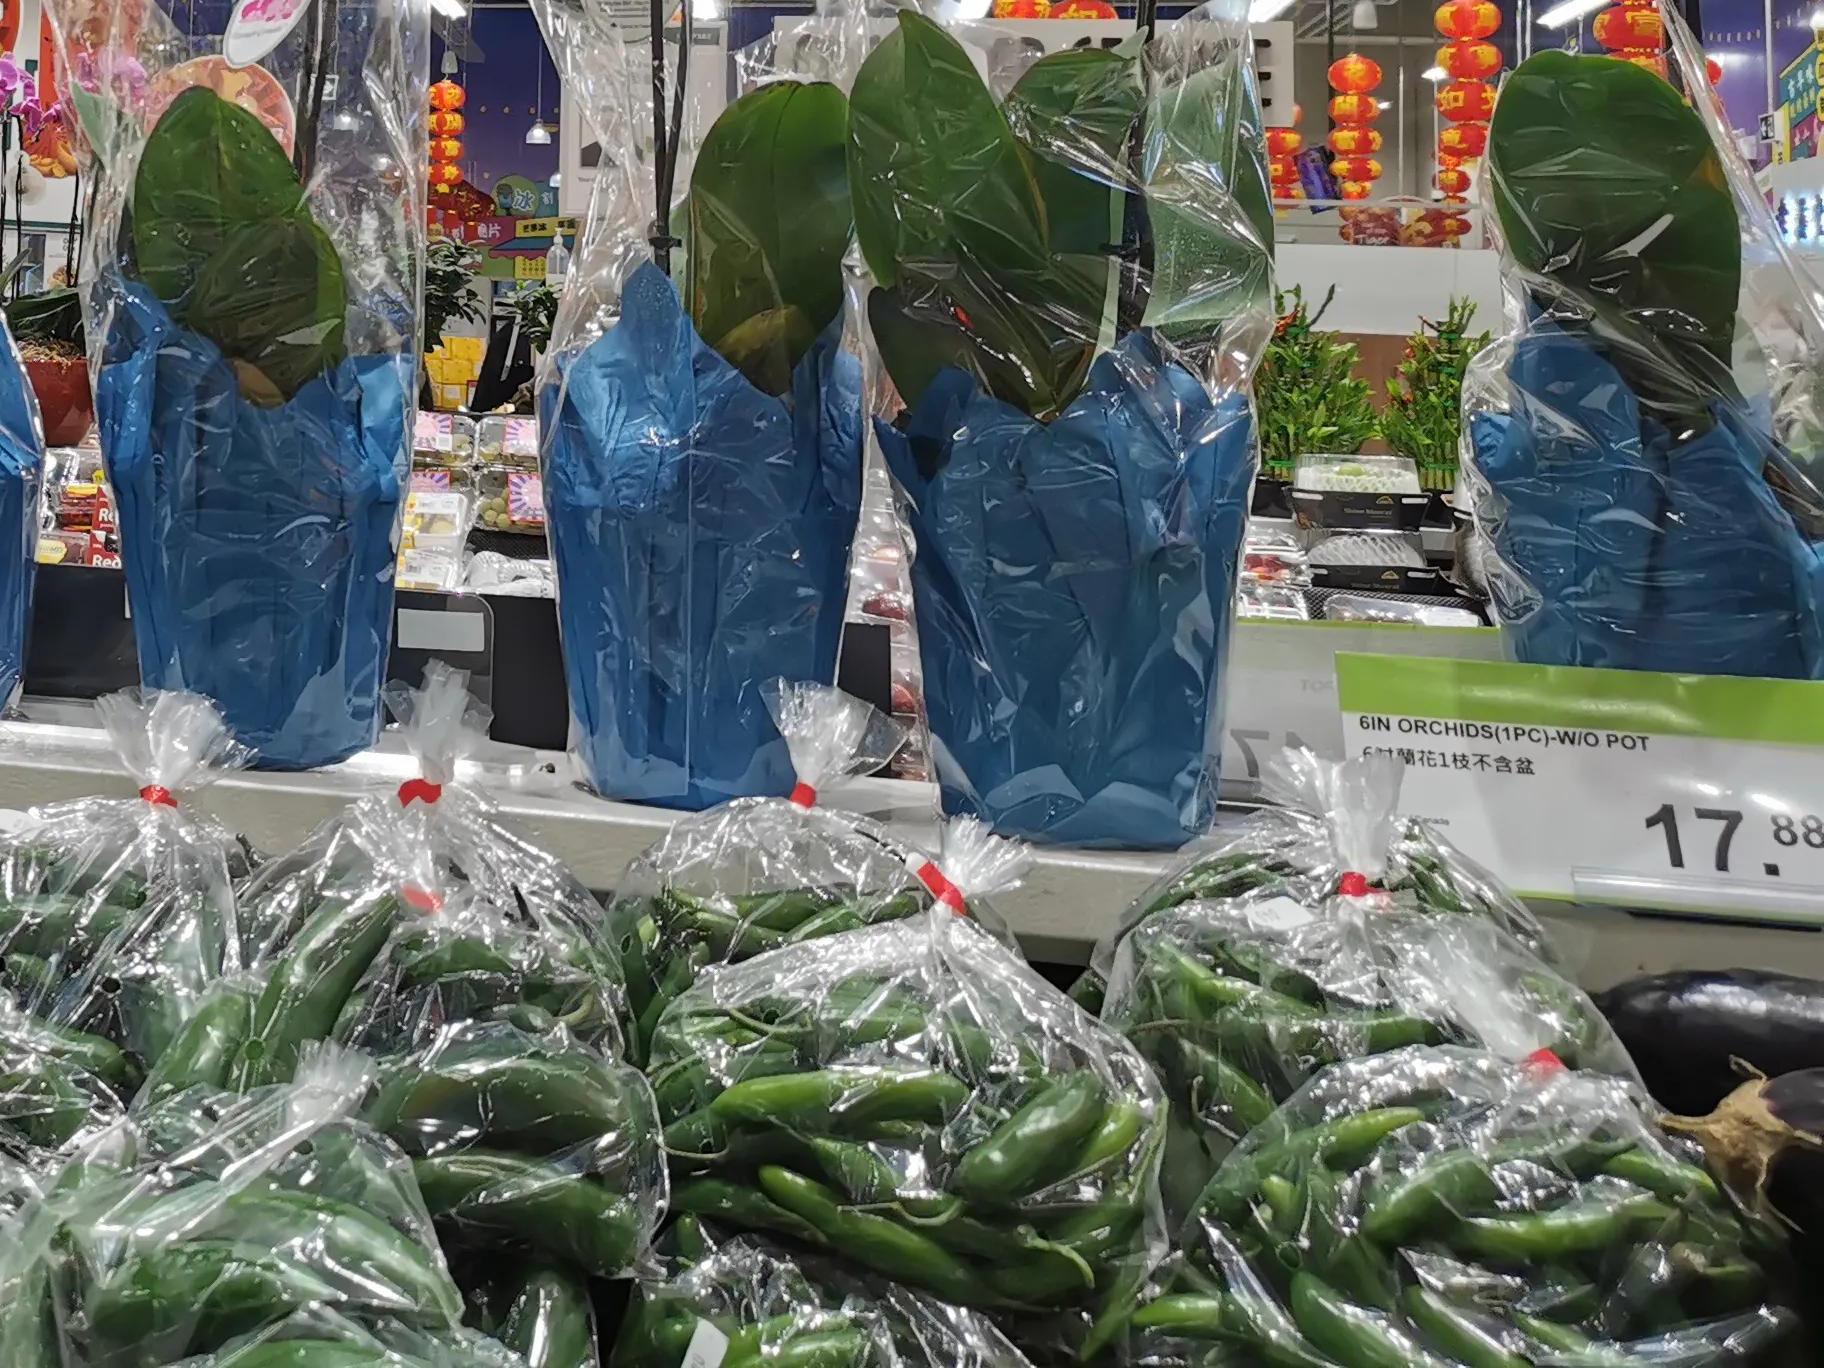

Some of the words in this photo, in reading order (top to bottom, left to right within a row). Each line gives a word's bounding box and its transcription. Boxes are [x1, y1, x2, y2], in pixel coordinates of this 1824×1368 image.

[1359, 714, 1393, 733] 6IN
[1397, 718, 1602, 750] ORCHIDS(1PC)-W/O
[1606, 733, 1651, 753] POT
[1643, 802, 1824, 878] 17.88
